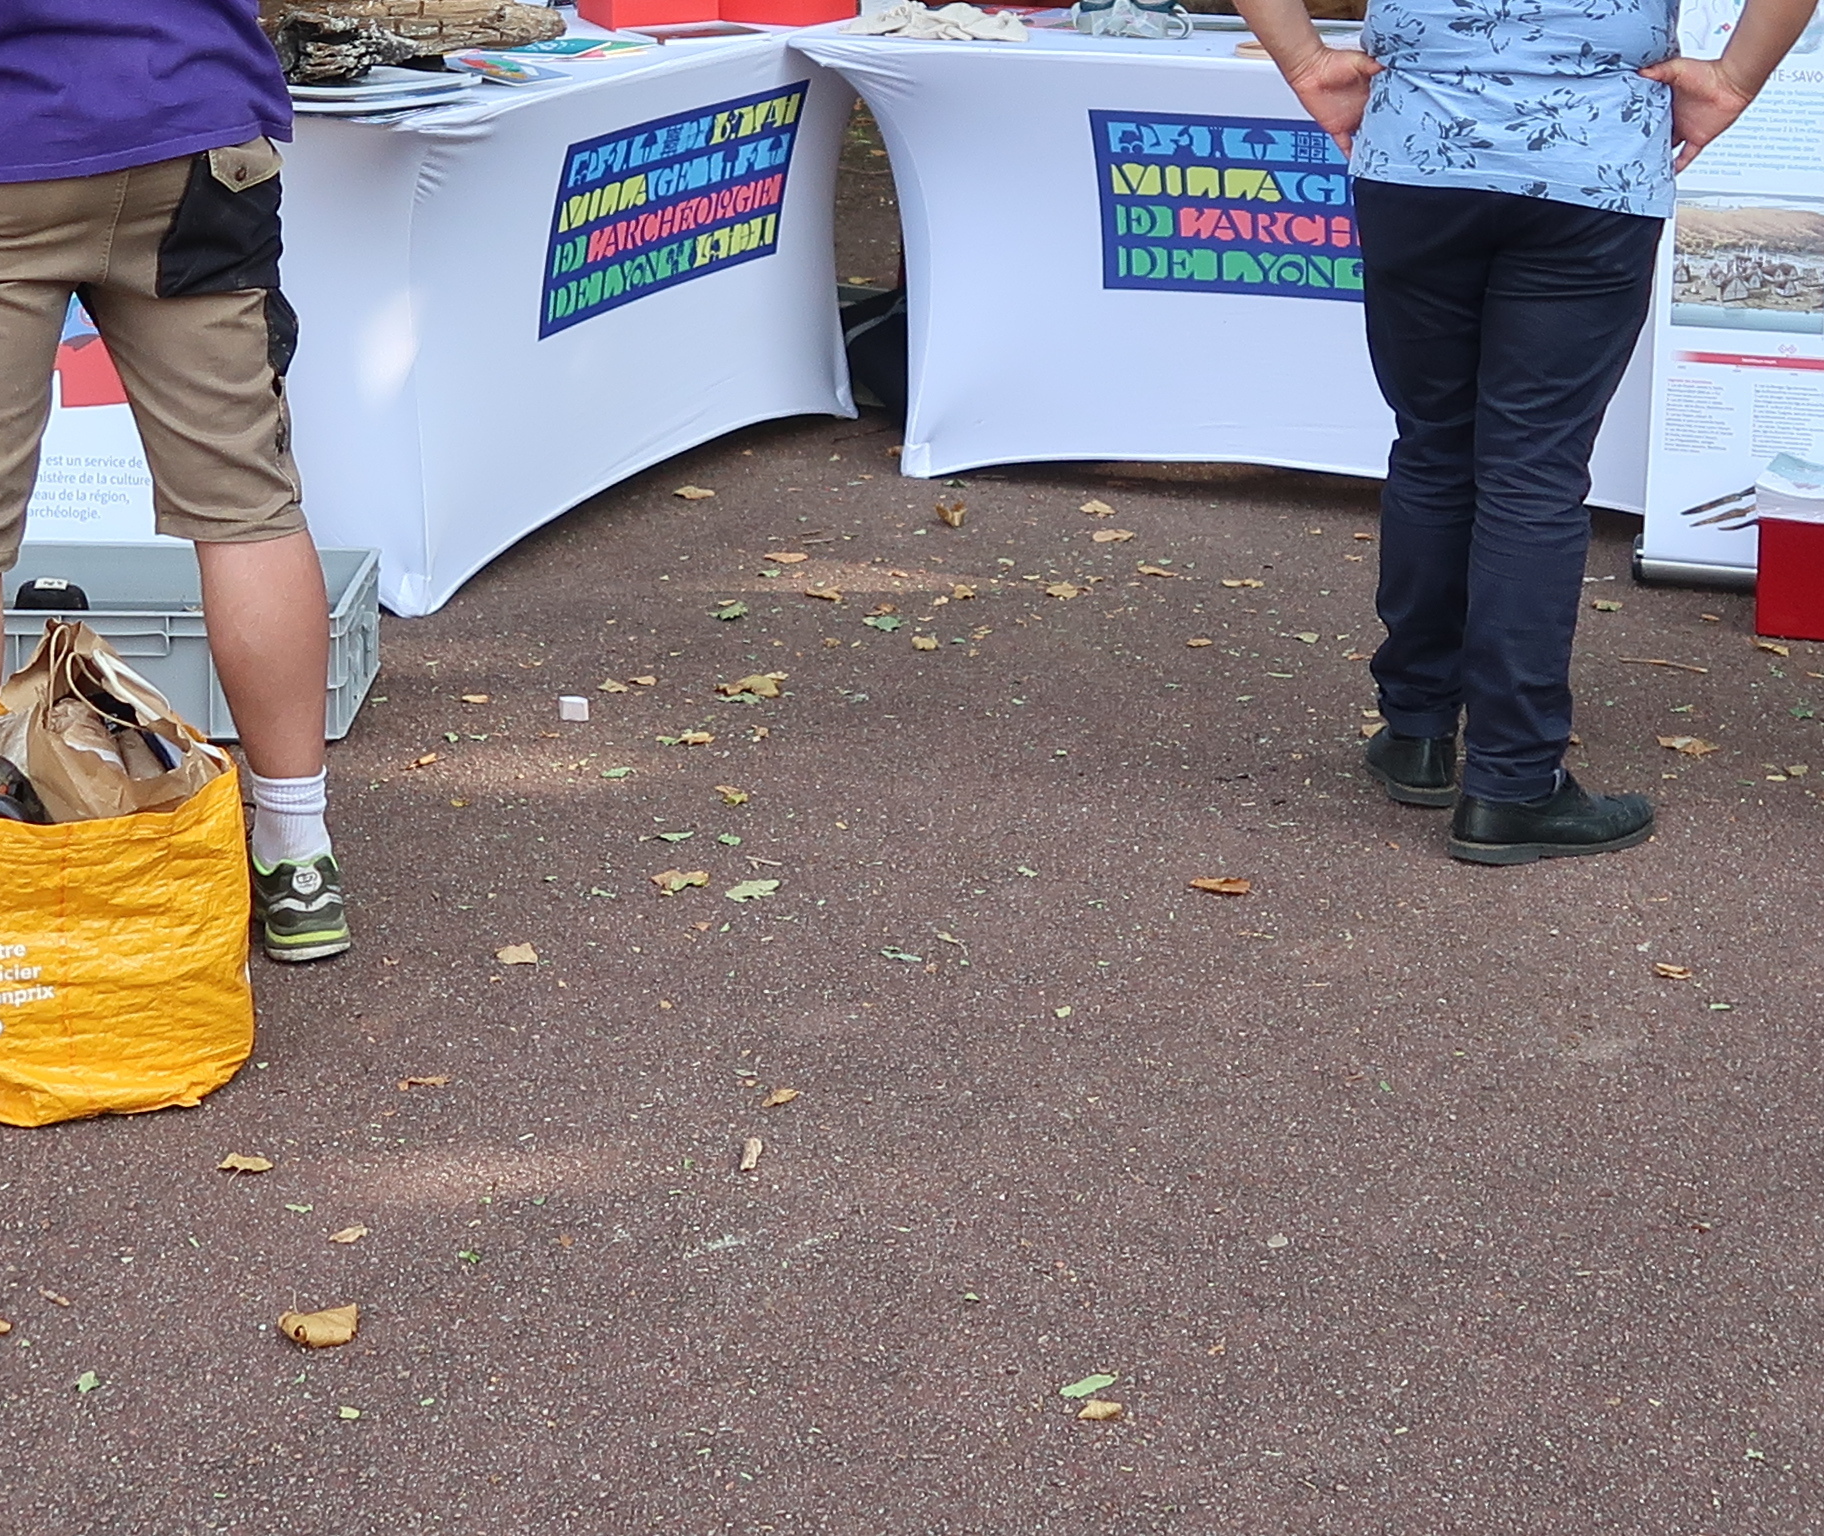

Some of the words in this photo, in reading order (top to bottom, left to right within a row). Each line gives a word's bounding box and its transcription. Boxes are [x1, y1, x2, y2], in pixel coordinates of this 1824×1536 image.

[45, 456, 63, 466] est
[66, 457, 82, 466] un
[84, 456, 126, 467] service
[128, 457, 143, 468] de
[78, 472, 94, 484] de
[96, 472, 107, 484] la
[109, 473, 152, 486] culture
[58, 489, 74, 501] de
[76, 489, 87, 501] la
[89, 490, 130, 505] région,
